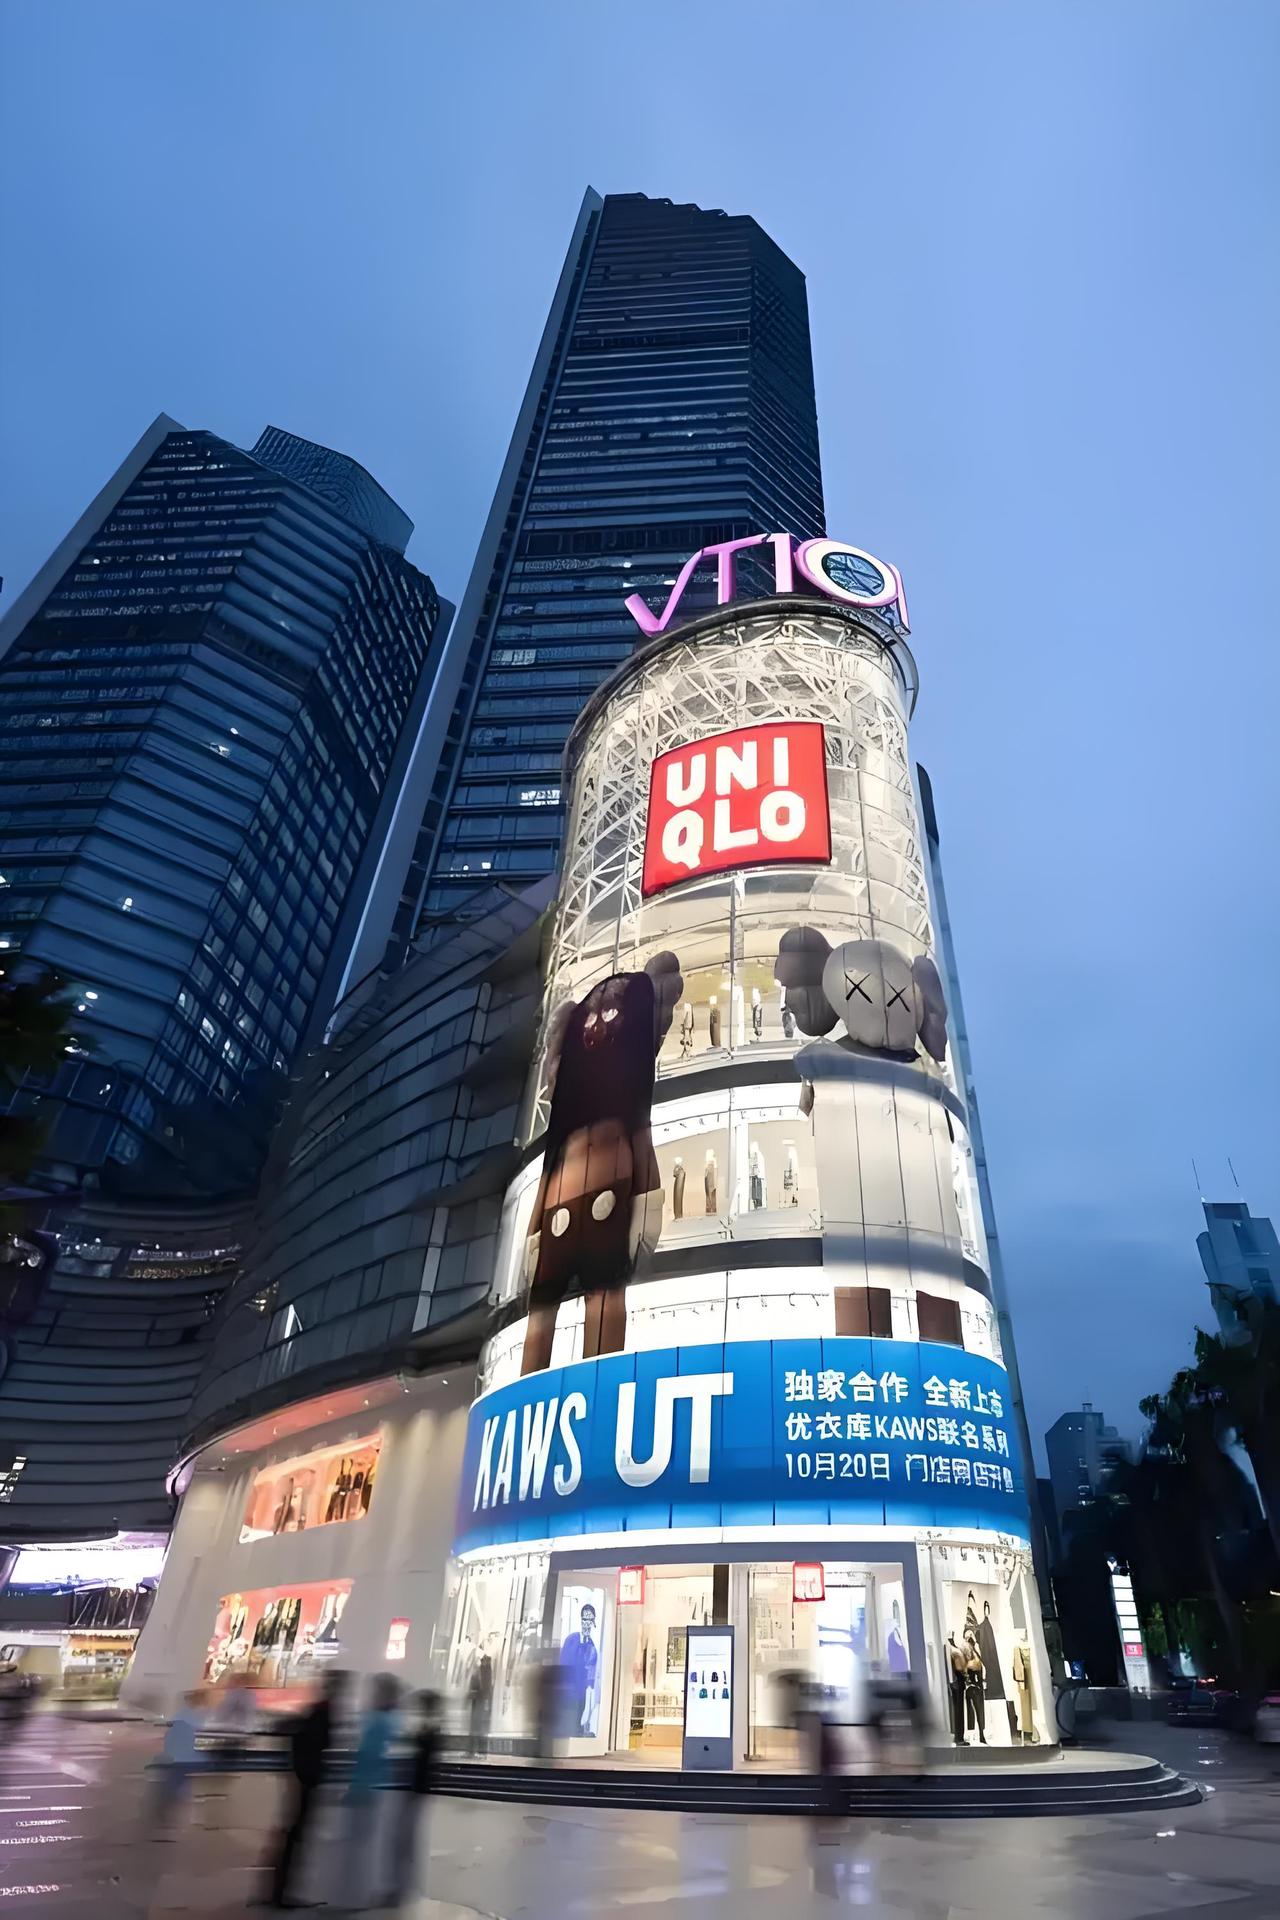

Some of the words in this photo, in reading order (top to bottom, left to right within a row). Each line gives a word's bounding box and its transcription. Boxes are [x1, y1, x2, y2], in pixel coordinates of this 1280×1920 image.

[666, 737, 790, 807] UNI
[662, 790, 806, 870] QLO
[784, 1369, 910, 1403] 独家合作
[473, 1392, 587, 1512] KAWS
[615, 1372, 734, 1488] UT
[785, 1452, 890, 1482] 10月20日
